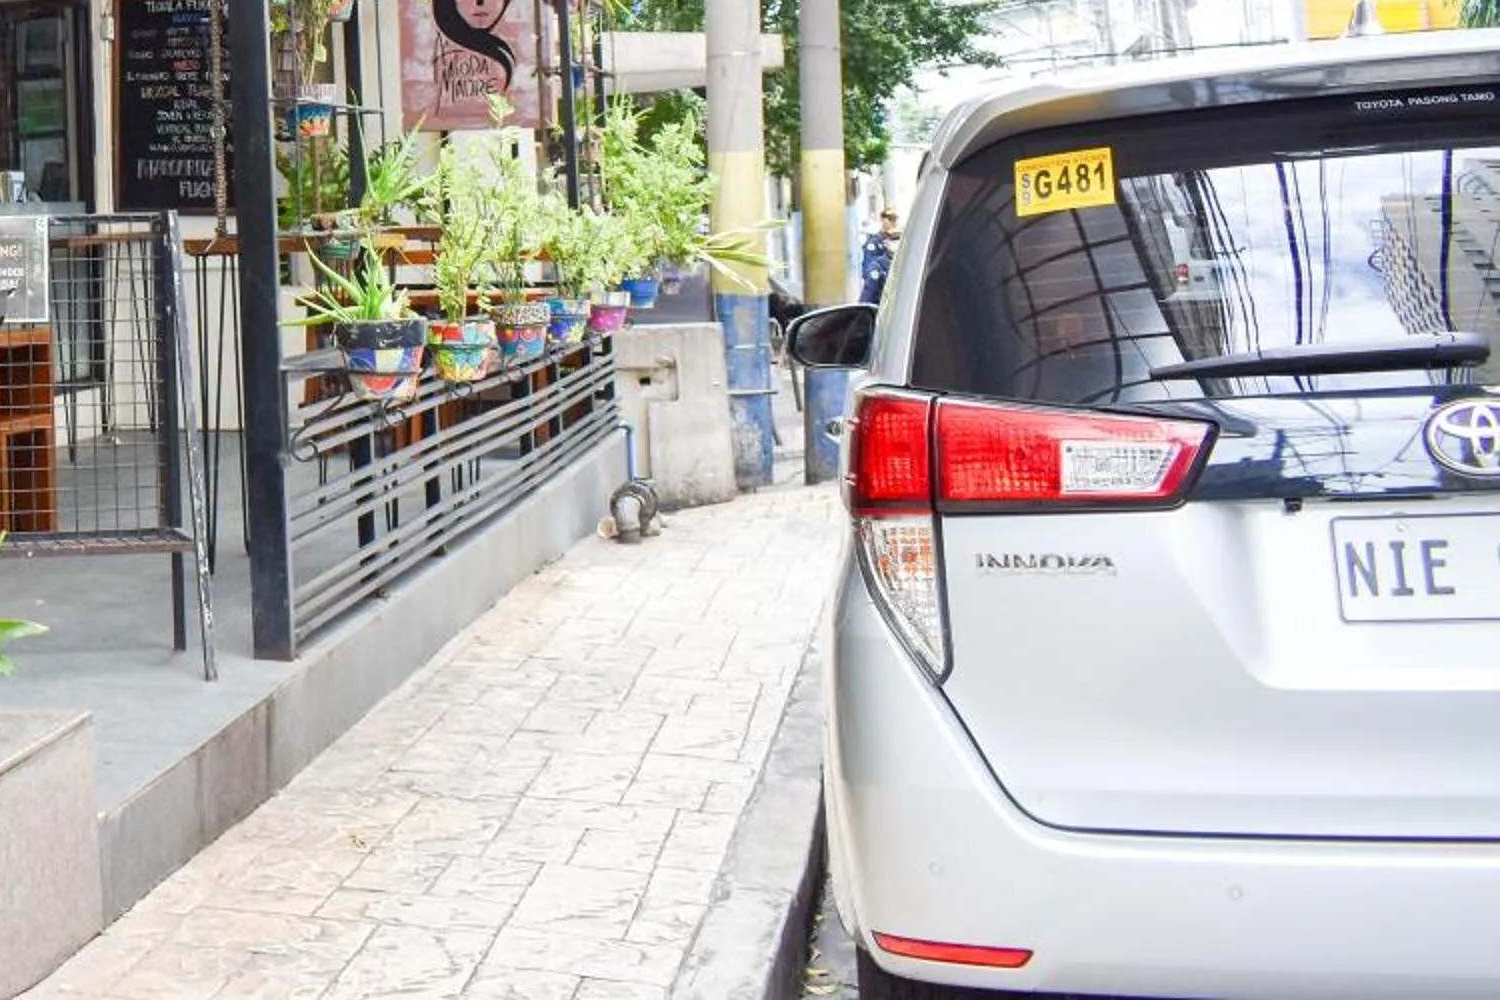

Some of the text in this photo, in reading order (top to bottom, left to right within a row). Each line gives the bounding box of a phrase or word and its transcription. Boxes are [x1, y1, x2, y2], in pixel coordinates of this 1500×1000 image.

[1354, 99, 1404, 110] TOYOTA
[1407, 95, 1459, 105] PASONG
[1034, 161, 1106, 199] G481
[975, 552, 1117, 574] INNOVA
[1344, 539, 1456, 598] NIE
